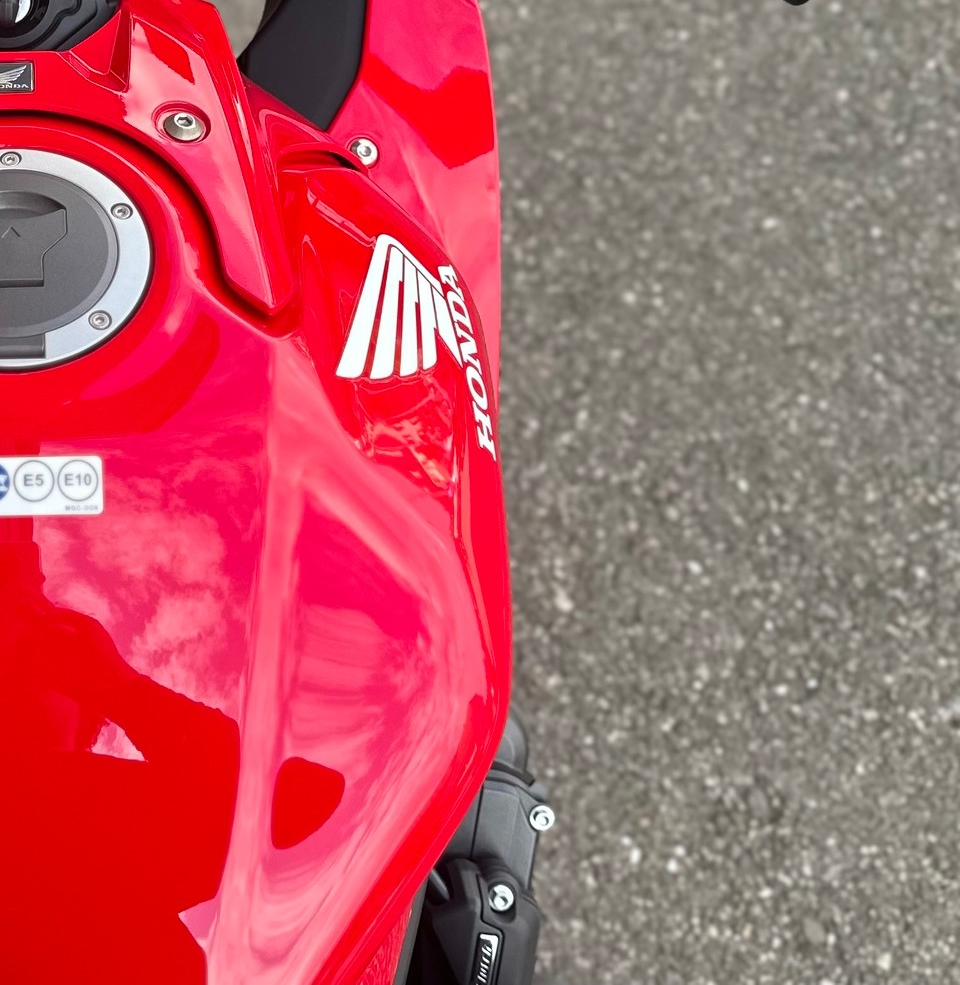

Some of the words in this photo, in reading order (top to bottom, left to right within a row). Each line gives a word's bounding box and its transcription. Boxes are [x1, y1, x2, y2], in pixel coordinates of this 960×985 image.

[438, 264, 497, 461] HONDA
[24, 474, 44, 487] E5
[64, 473, 92, 487] E10
